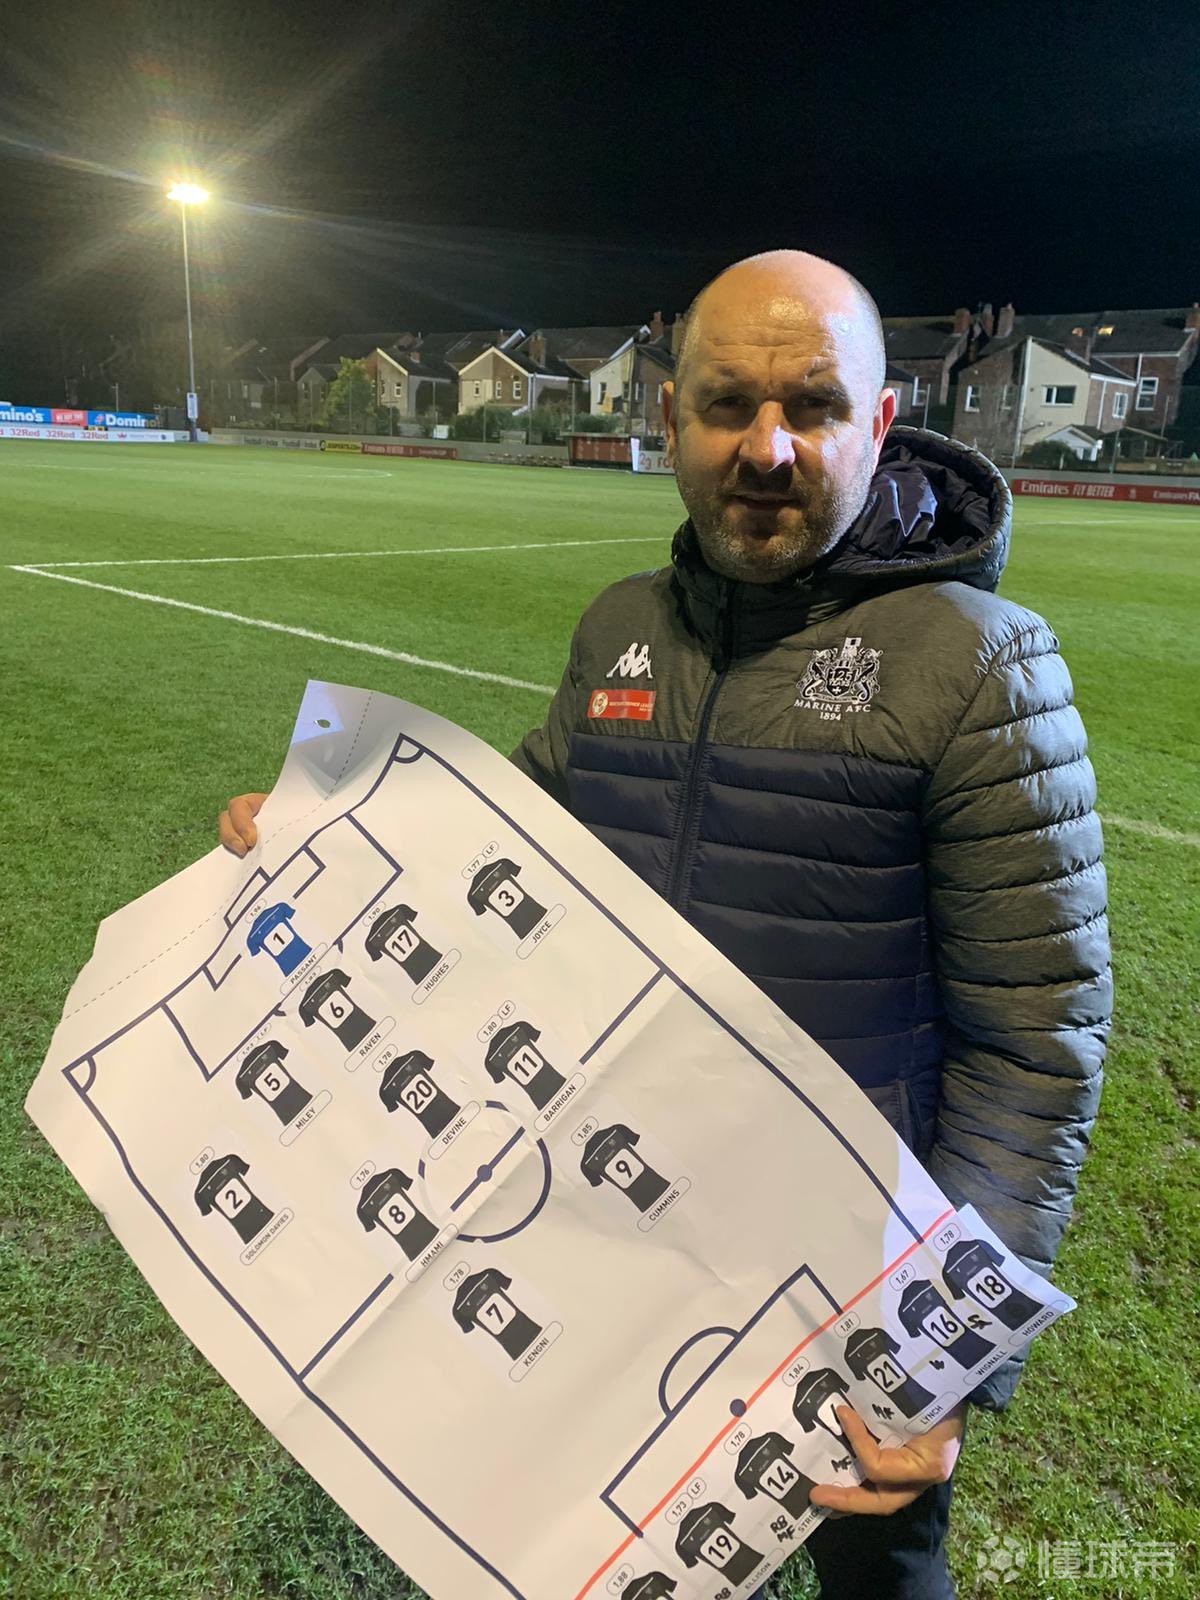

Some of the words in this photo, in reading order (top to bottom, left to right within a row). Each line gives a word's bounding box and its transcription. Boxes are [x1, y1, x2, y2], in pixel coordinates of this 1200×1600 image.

[10, 428, 40, 437] 32Red
[46, 430, 75, 439] 32Red
[1021, 481, 1069, 495] Emirates
[1086, 484, 1115, 497] BETTER
[830, 671, 853, 680] 125
[794, 700, 841, 712] MARINE
[845, 704, 871, 713] AFC
[820, 712, 841, 720] 1894
[485, 844, 495, 855] LF
[498, 890, 515, 907] 3
[273, 933, 285, 945] 1
[391, 929, 413, 955] 17
[532, 921, 552, 943] JOYCE
[290, 954, 317, 984] PASSANT
[423, 962, 450, 991] HUGHES
[330, 1002, 344, 1018] 6
[501, 1004, 511, 1015] LF
[359, 1032, 381, 1057] RAVEN
[515, 1052, 538, 1077] 11
[263, 1072, 280, 1091] 5
[406, 1080, 432, 1111] 20
[543, 1084, 576, 1122] BARRIGAN
[295, 1107, 316, 1130] MILEY
[442, 1117, 467, 1144] DEVINE
[615, 1160, 632, 1179] 9
[225, 1190, 243, 1209] 2
[649, 1189, 680, 1221] CUMMINS
[388, 1205, 406, 1224] 8
[245, 1232, 271, 1260] SOLOMON
[269, 1213, 289, 1235] DAVIES
[420, 1241, 445, 1268] HMAMI
[975, 1275, 1005, 1301] 18
[485, 1302, 504, 1325] 7
[1022, 1311, 1055, 1337] HOWARD
[930, 1314, 958, 1340] 16
[522, 1337, 550, 1367] KENGNI
[975, 1350, 1007, 1376] WIGNALL
[873, 1360, 901, 1389] 21
[920, 1405, 944, 1425] LYNCH
[690, 1483, 701, 1495] LF
[767, 1466, 795, 1491] 14
[770, 1515, 788, 1533] RB
[708, 1535, 733, 1560] 19
[745, 1562, 772, 1590] ELLISON
